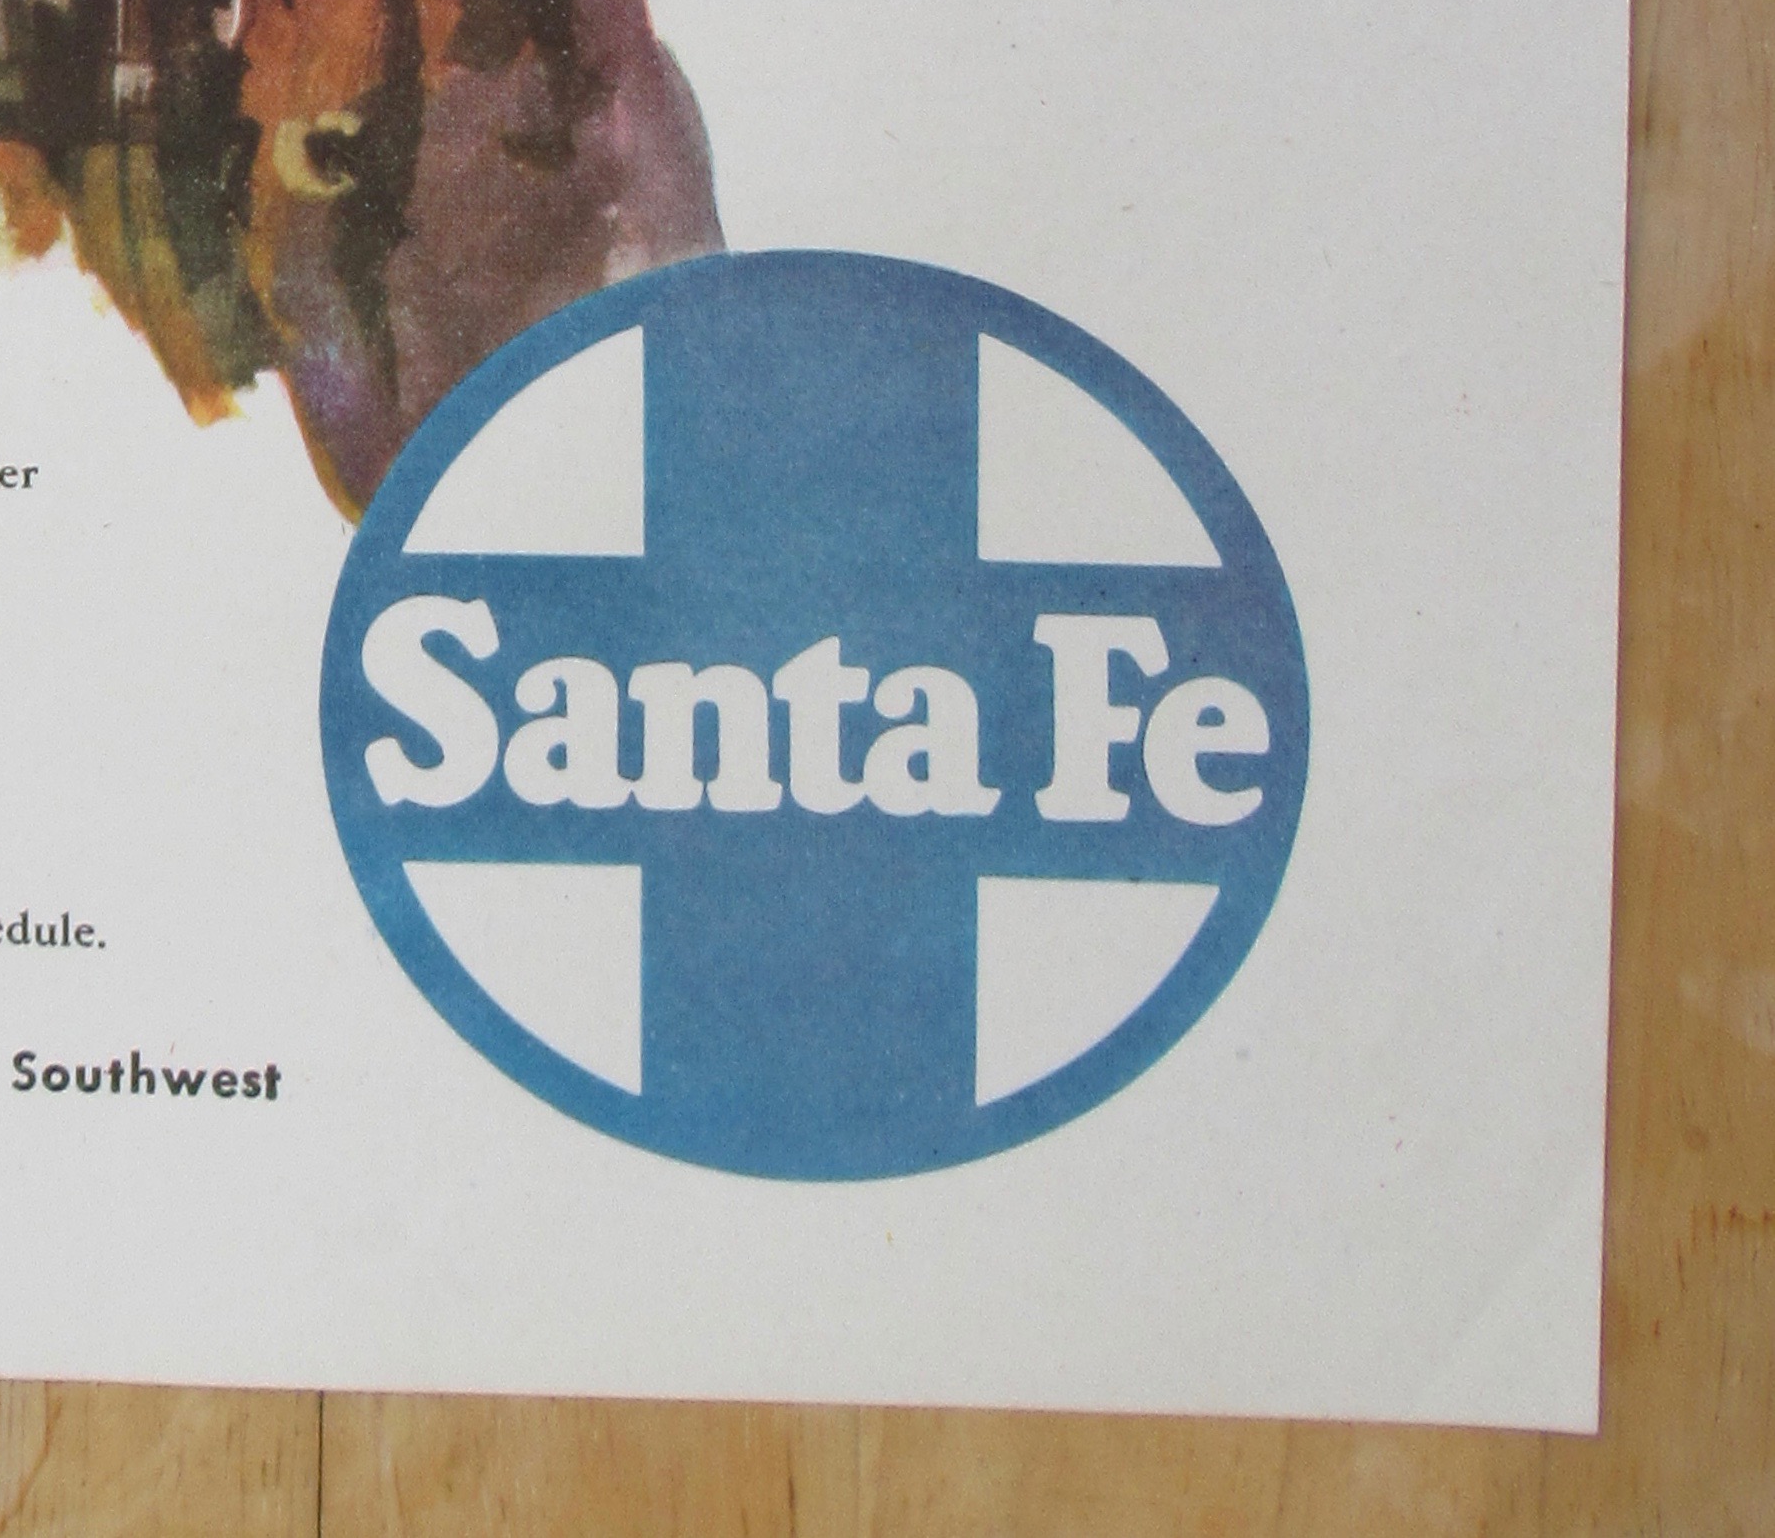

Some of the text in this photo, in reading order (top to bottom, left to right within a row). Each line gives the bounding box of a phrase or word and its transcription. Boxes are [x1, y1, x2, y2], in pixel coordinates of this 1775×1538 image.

[361, 595, 1270, 826] Santa Fe
[10, 1048, 283, 1103] Southwest
